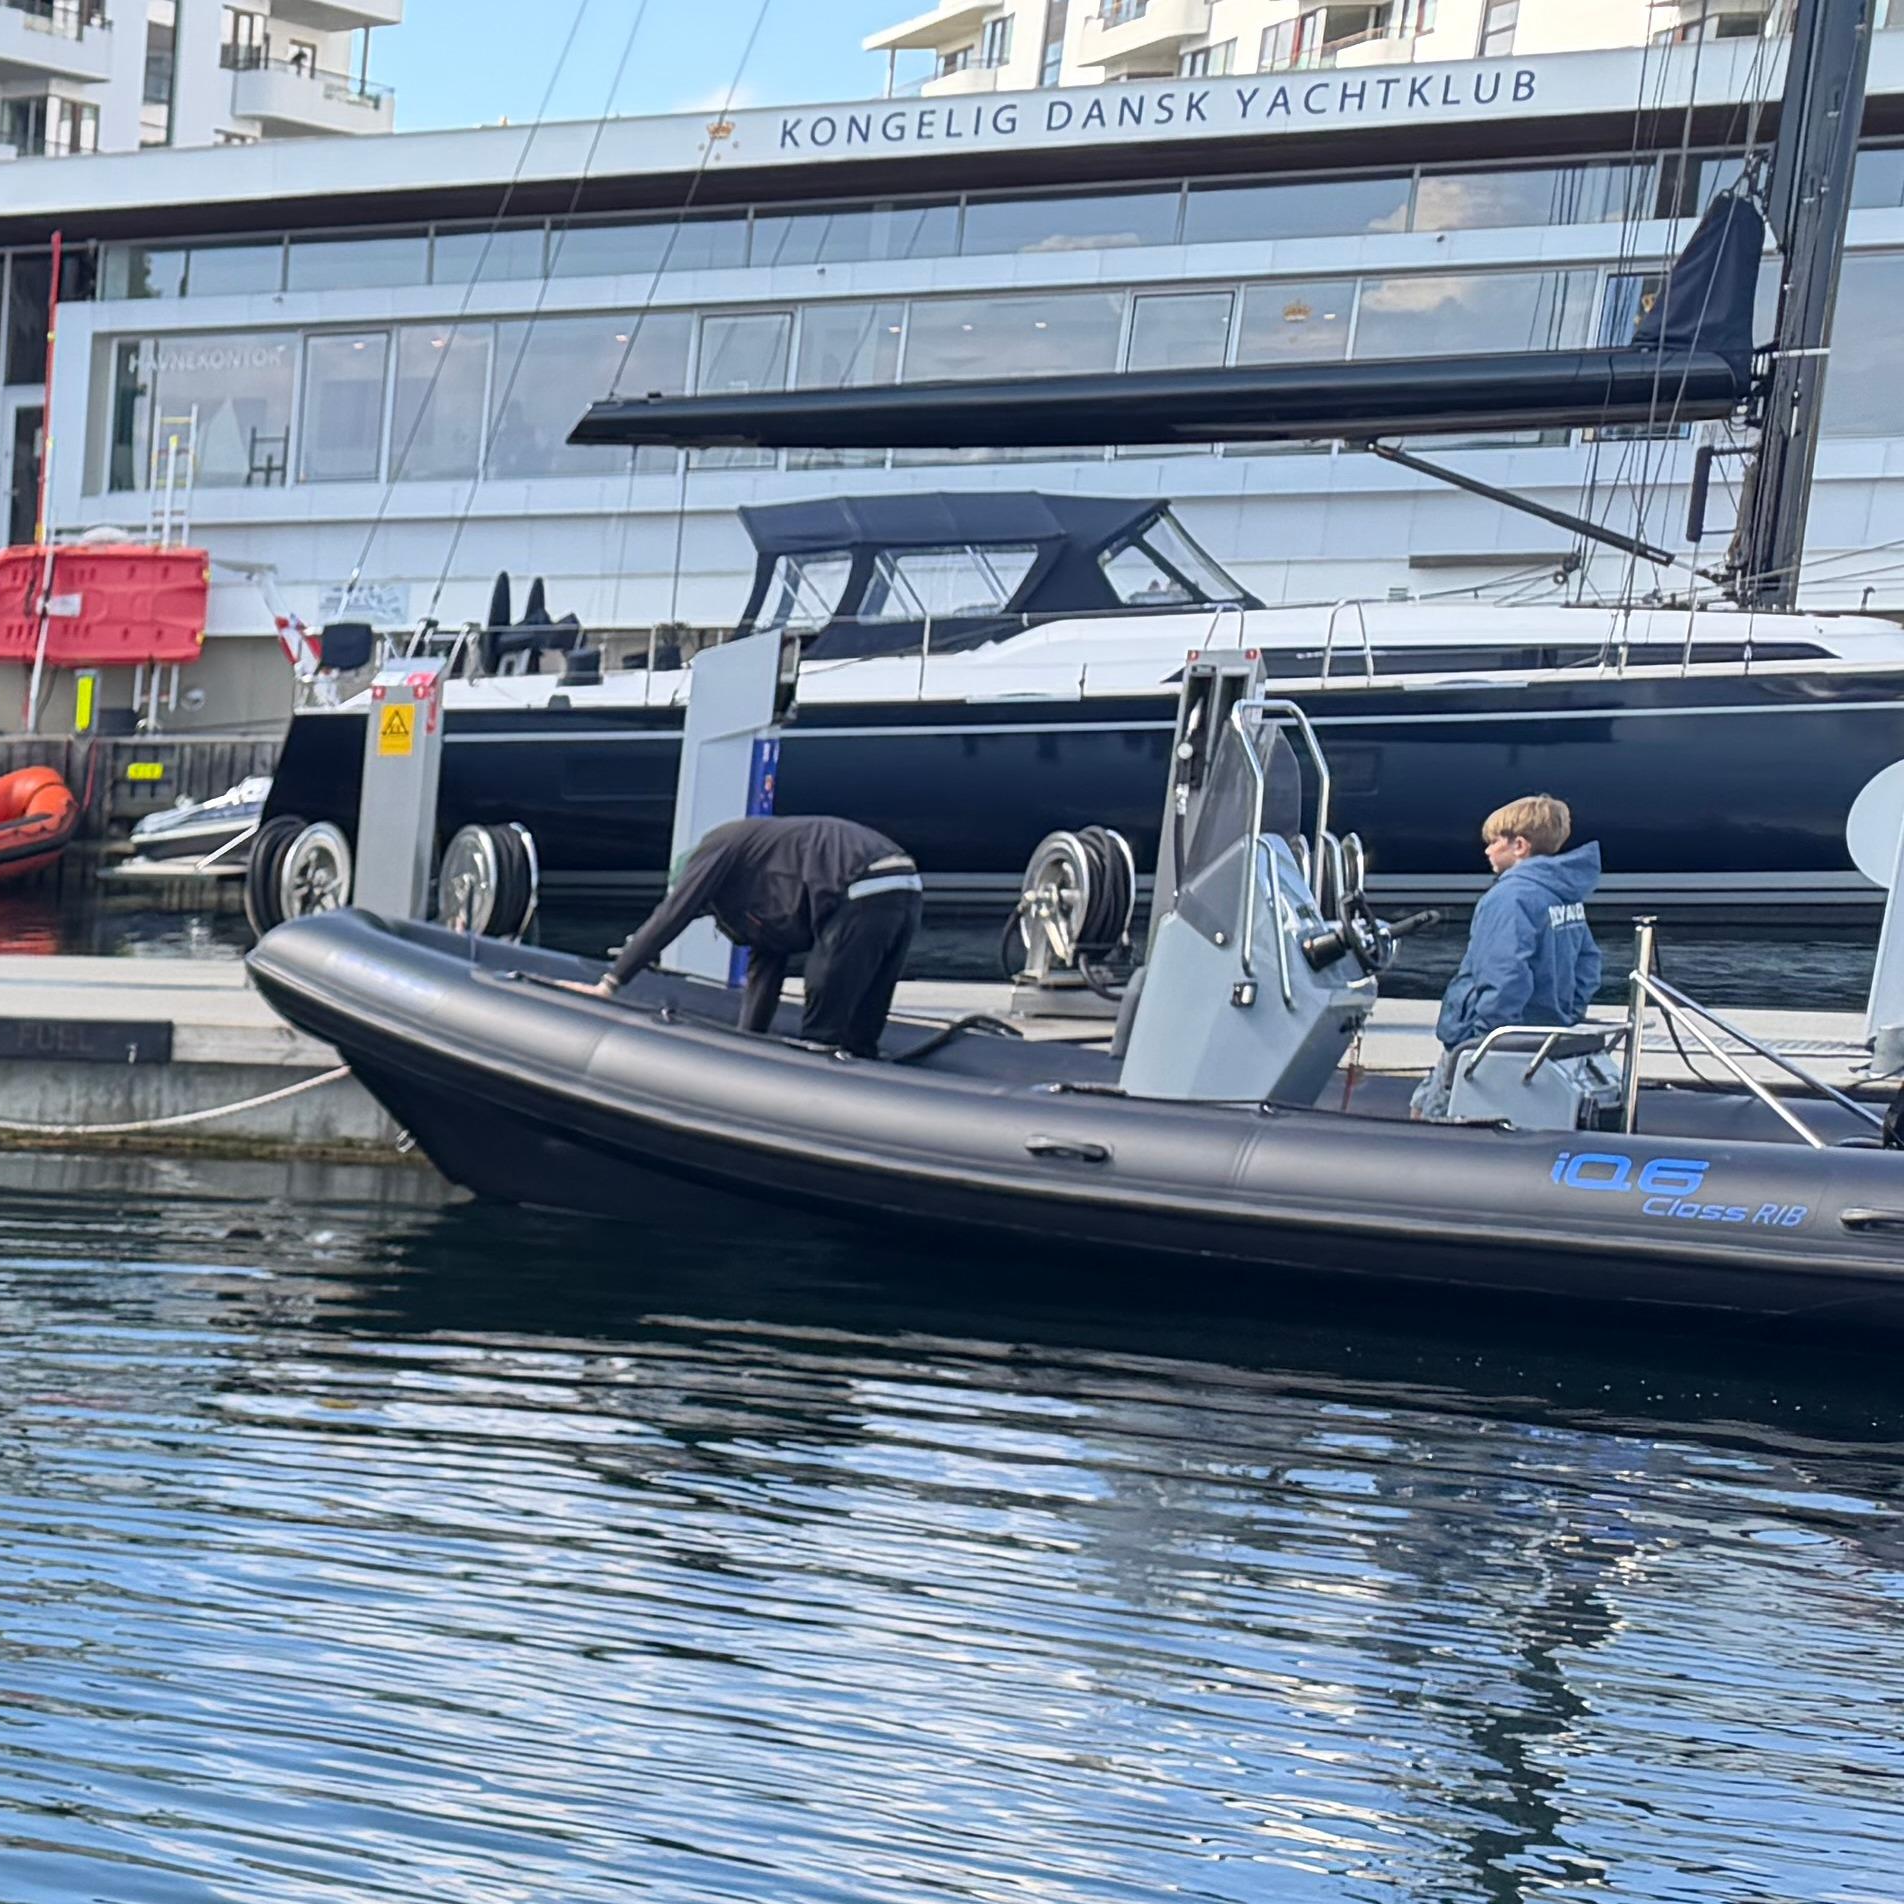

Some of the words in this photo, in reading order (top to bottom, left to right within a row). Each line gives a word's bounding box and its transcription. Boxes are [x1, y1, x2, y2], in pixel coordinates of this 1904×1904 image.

[780, 103, 1019, 149] KONGELIG
[1047, 88, 1210, 131] DANSK
[1237, 69, 1537, 119] YACHTKLUB
[1641, 1198, 1749, 1222] Class
[1751, 1202, 1808, 1227] RIB
